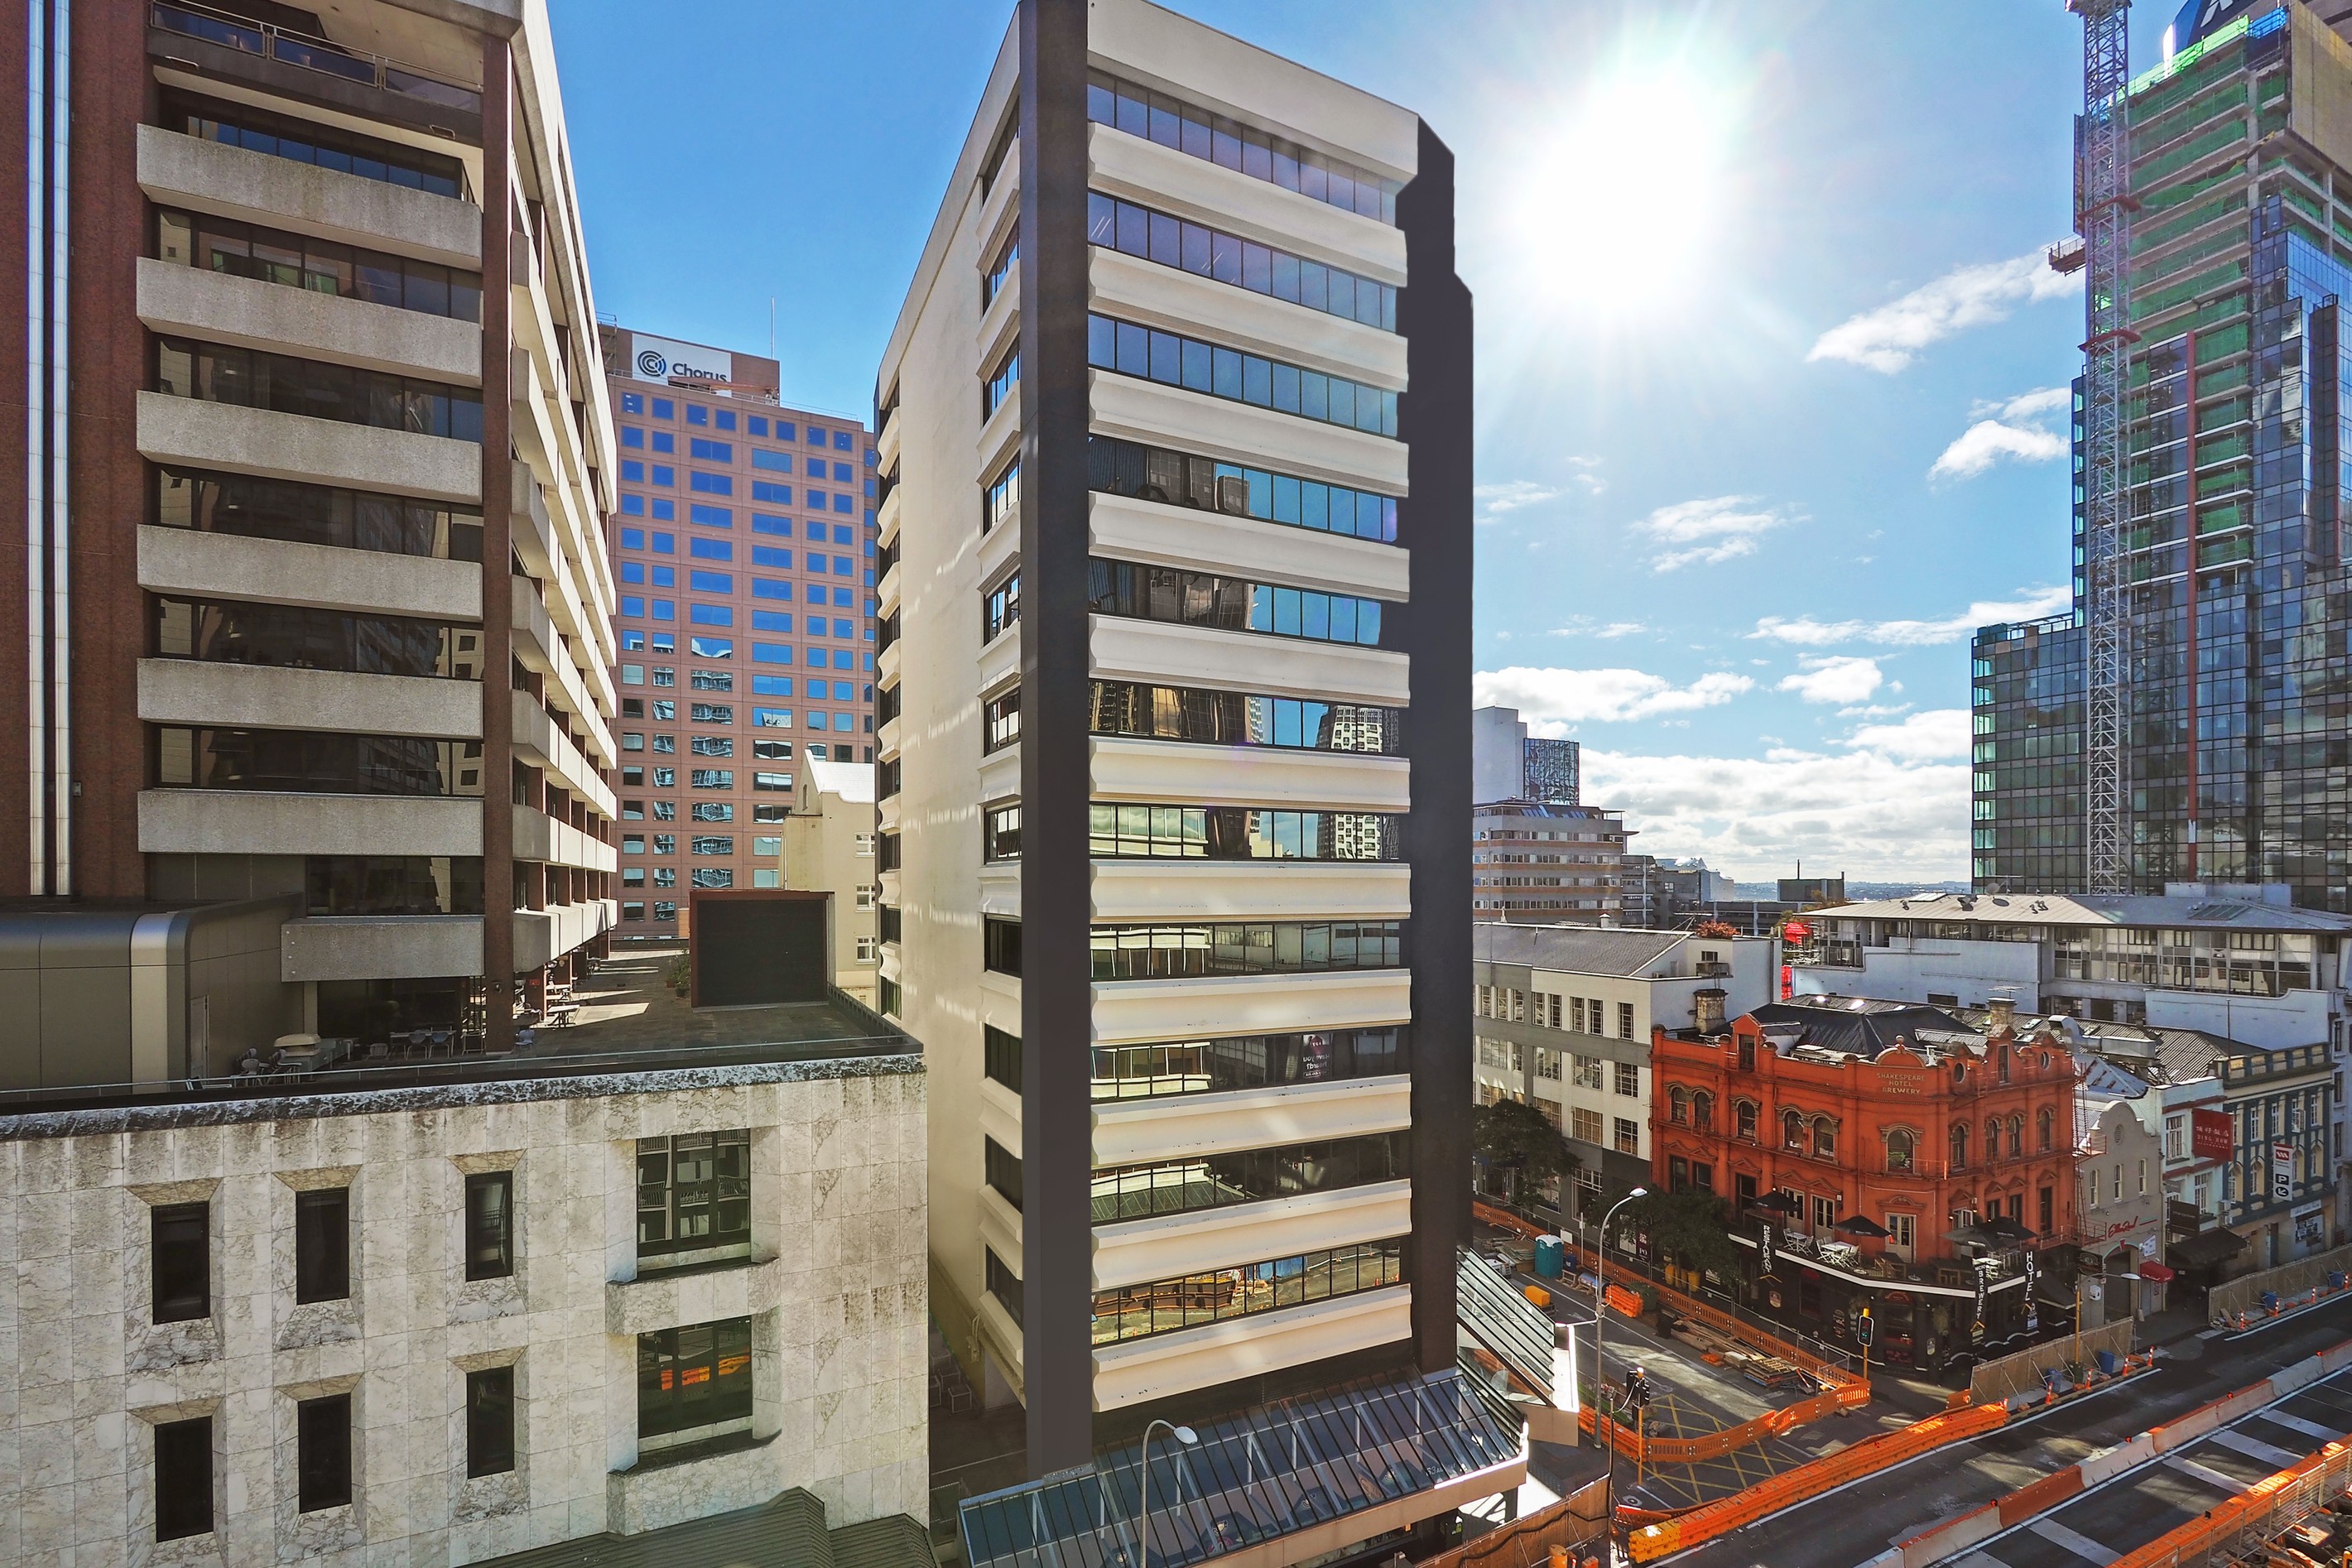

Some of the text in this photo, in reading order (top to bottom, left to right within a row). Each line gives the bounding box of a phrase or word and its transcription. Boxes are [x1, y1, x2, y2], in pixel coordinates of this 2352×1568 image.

[672, 363, 728, 382] Chorus
[1876, 1072, 1926, 1081] SHAKESPEARE
[1882, 1086, 1921, 1094] BREWERY
[2025, 1251, 2035, 1301] HOTEL
[1976, 1270, 1985, 1320] BREWERY
